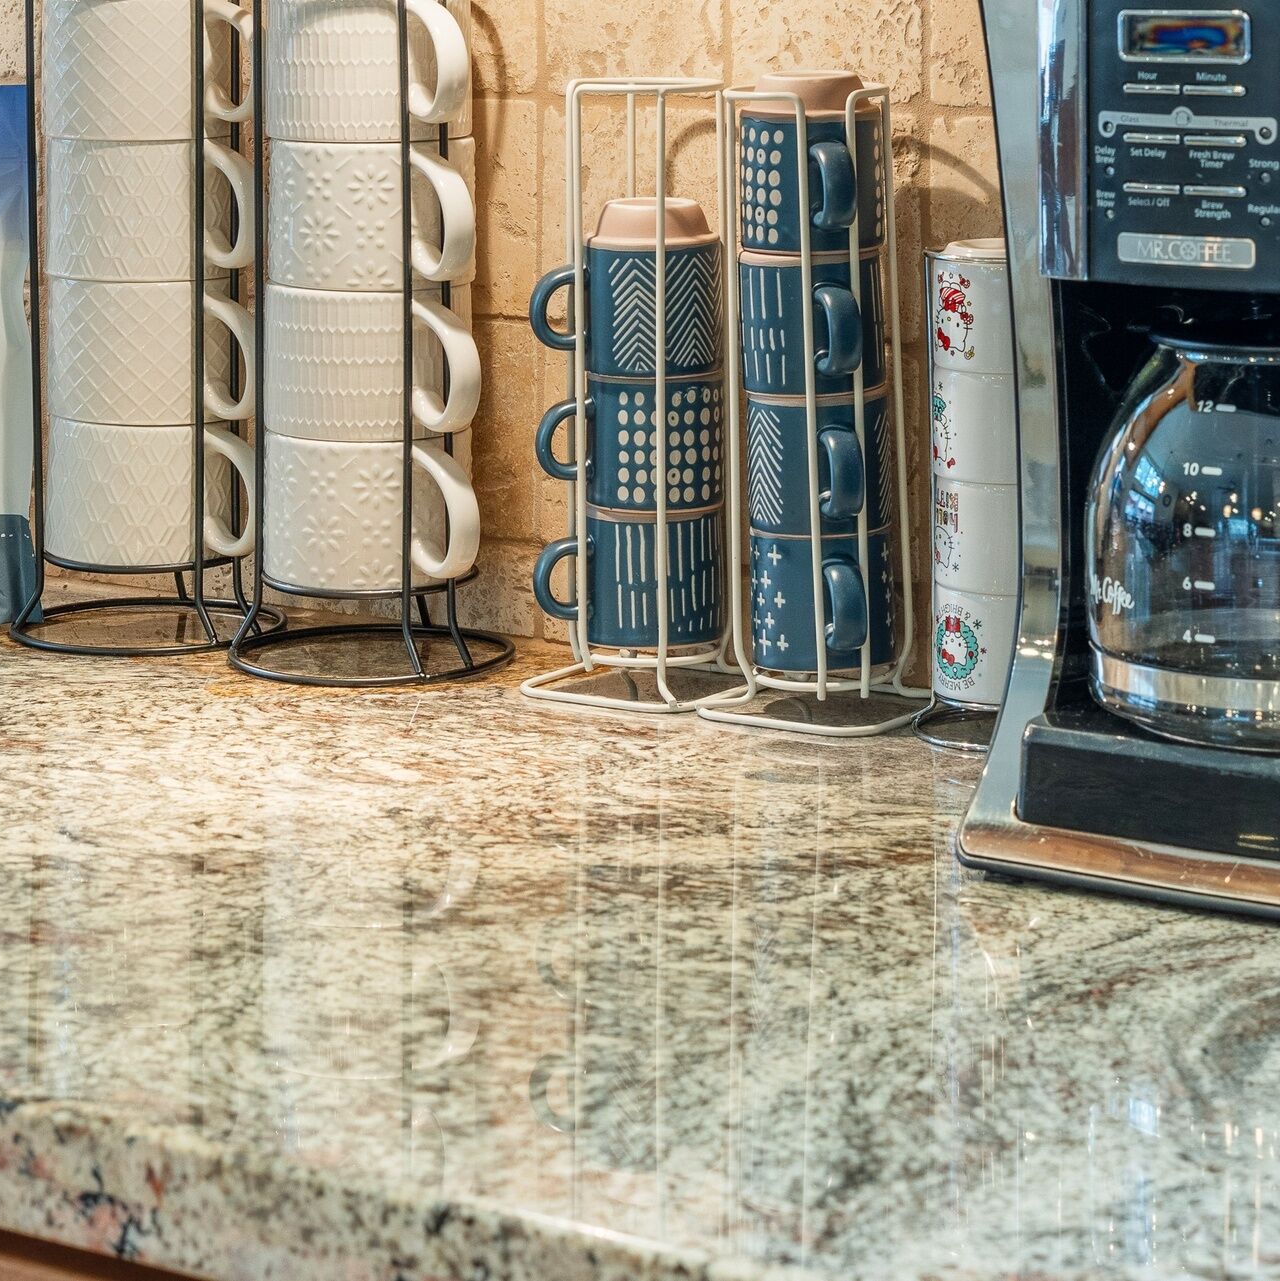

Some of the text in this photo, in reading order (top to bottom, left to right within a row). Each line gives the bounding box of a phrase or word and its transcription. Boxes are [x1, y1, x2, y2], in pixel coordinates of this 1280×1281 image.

[1138, 71, 1158, 81] Hour
[1196, 71, 1227, 82] Minute
[1094, 145, 1116, 157] Delay
[1130, 147, 1167, 159] Set Delay
[1189, 150, 1235, 161] Fresh Brew
[1095, 154, 1116, 164] Brew
[1200, 159, 1224, 169] Timer
[1249, 158, 1280, 170] Strong
[1096, 190, 1116, 199] Brew
[1096, 198, 1116, 208] Now
[1128, 197, 1151, 207] Select
[1156, 197, 1170, 207] Off
[1201, 199, 1224, 210] Brew
[1194, 208, 1232, 221] Strength
[1197, 400, 1214, 413] 12
[1182, 462, 1200, 477] 10
[1182, 523, 1193, 538] 8
[1182, 576, 1193, 590] 6
[1182, 630, 1193, 643] 4
